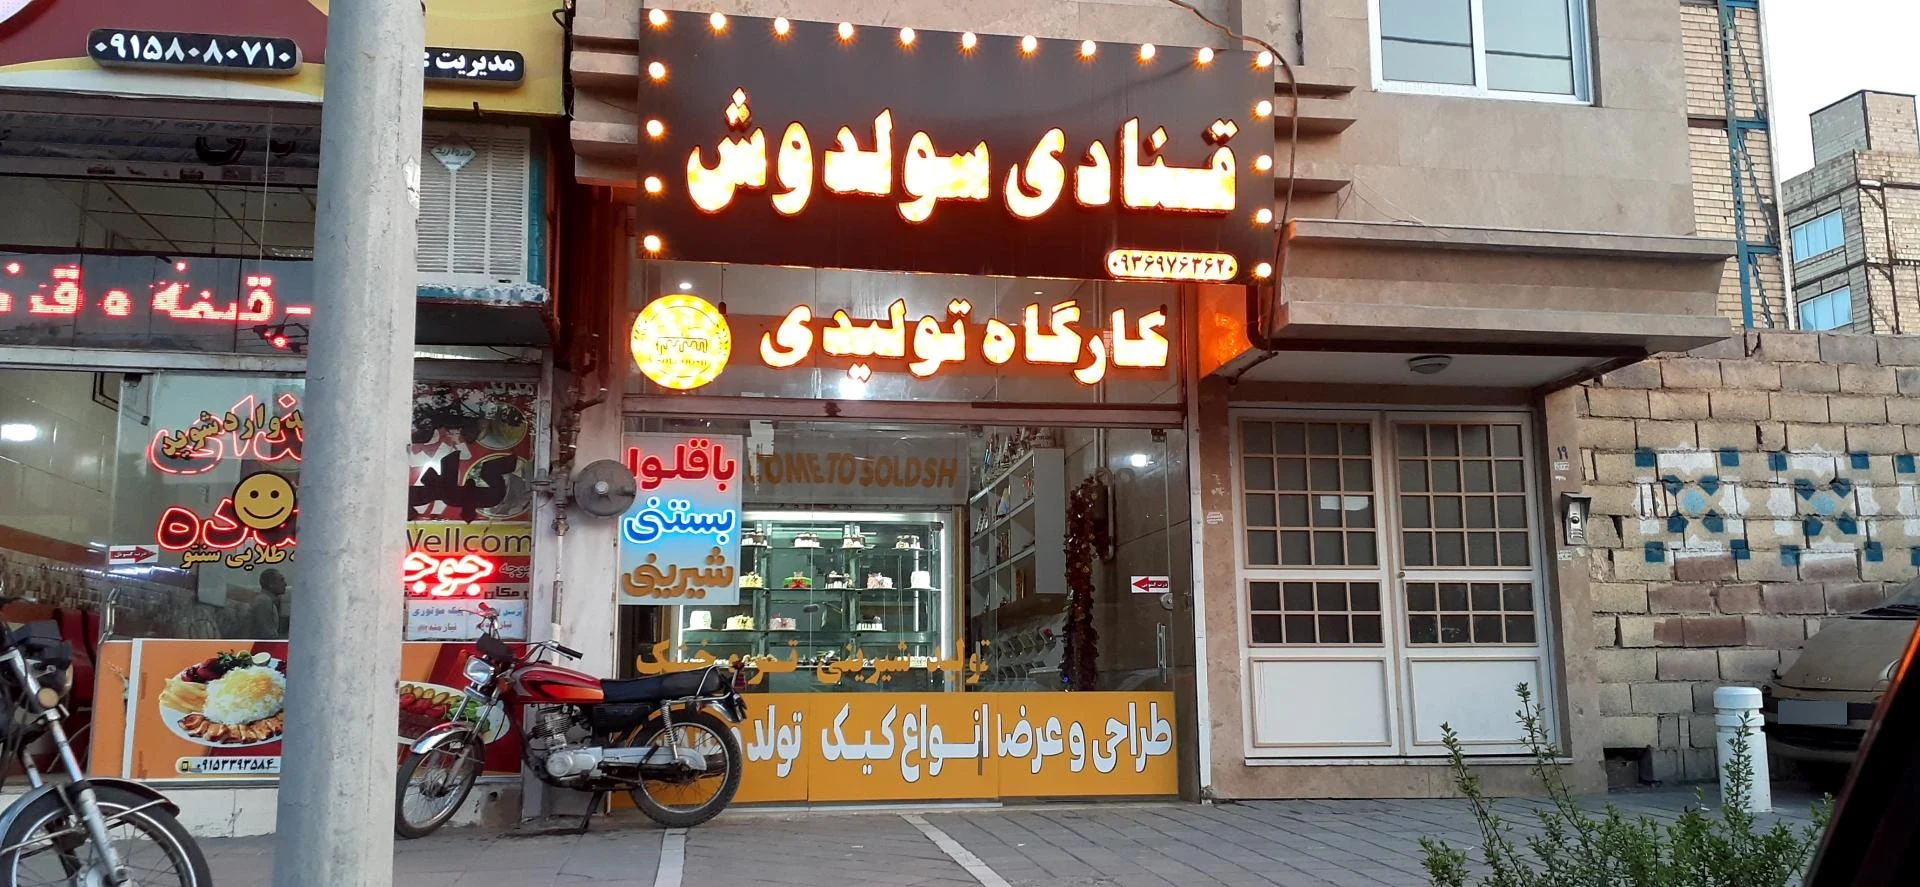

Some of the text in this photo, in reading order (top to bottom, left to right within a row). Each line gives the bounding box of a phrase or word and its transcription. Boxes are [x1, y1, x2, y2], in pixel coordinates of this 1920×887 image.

[95, 33, 291, 67] ۰۹۱۵۸۰۸۰۷۱۰
[686, 87, 1239, 224] قنادی سولدوش
[1112, 254, 1234, 275] ۰۹۳۶۹۷۶۳۶۲۰
[758, 298, 1170, 385] کارگاه تولیدی
[627, 438, 736, 492] باقلوا
[622, 496, 736, 546] بستنی
[621, 546, 735, 600] شیرینی
[816, 640, 910, 685] شیرینی
[745, 704, 803, 778] تولد
[820, 702, 898, 775] کیک
[900, 702, 990, 783] انواع
[1068, 720, 1086, 773] و
[1091, 701, 1173, 774] طراحی
